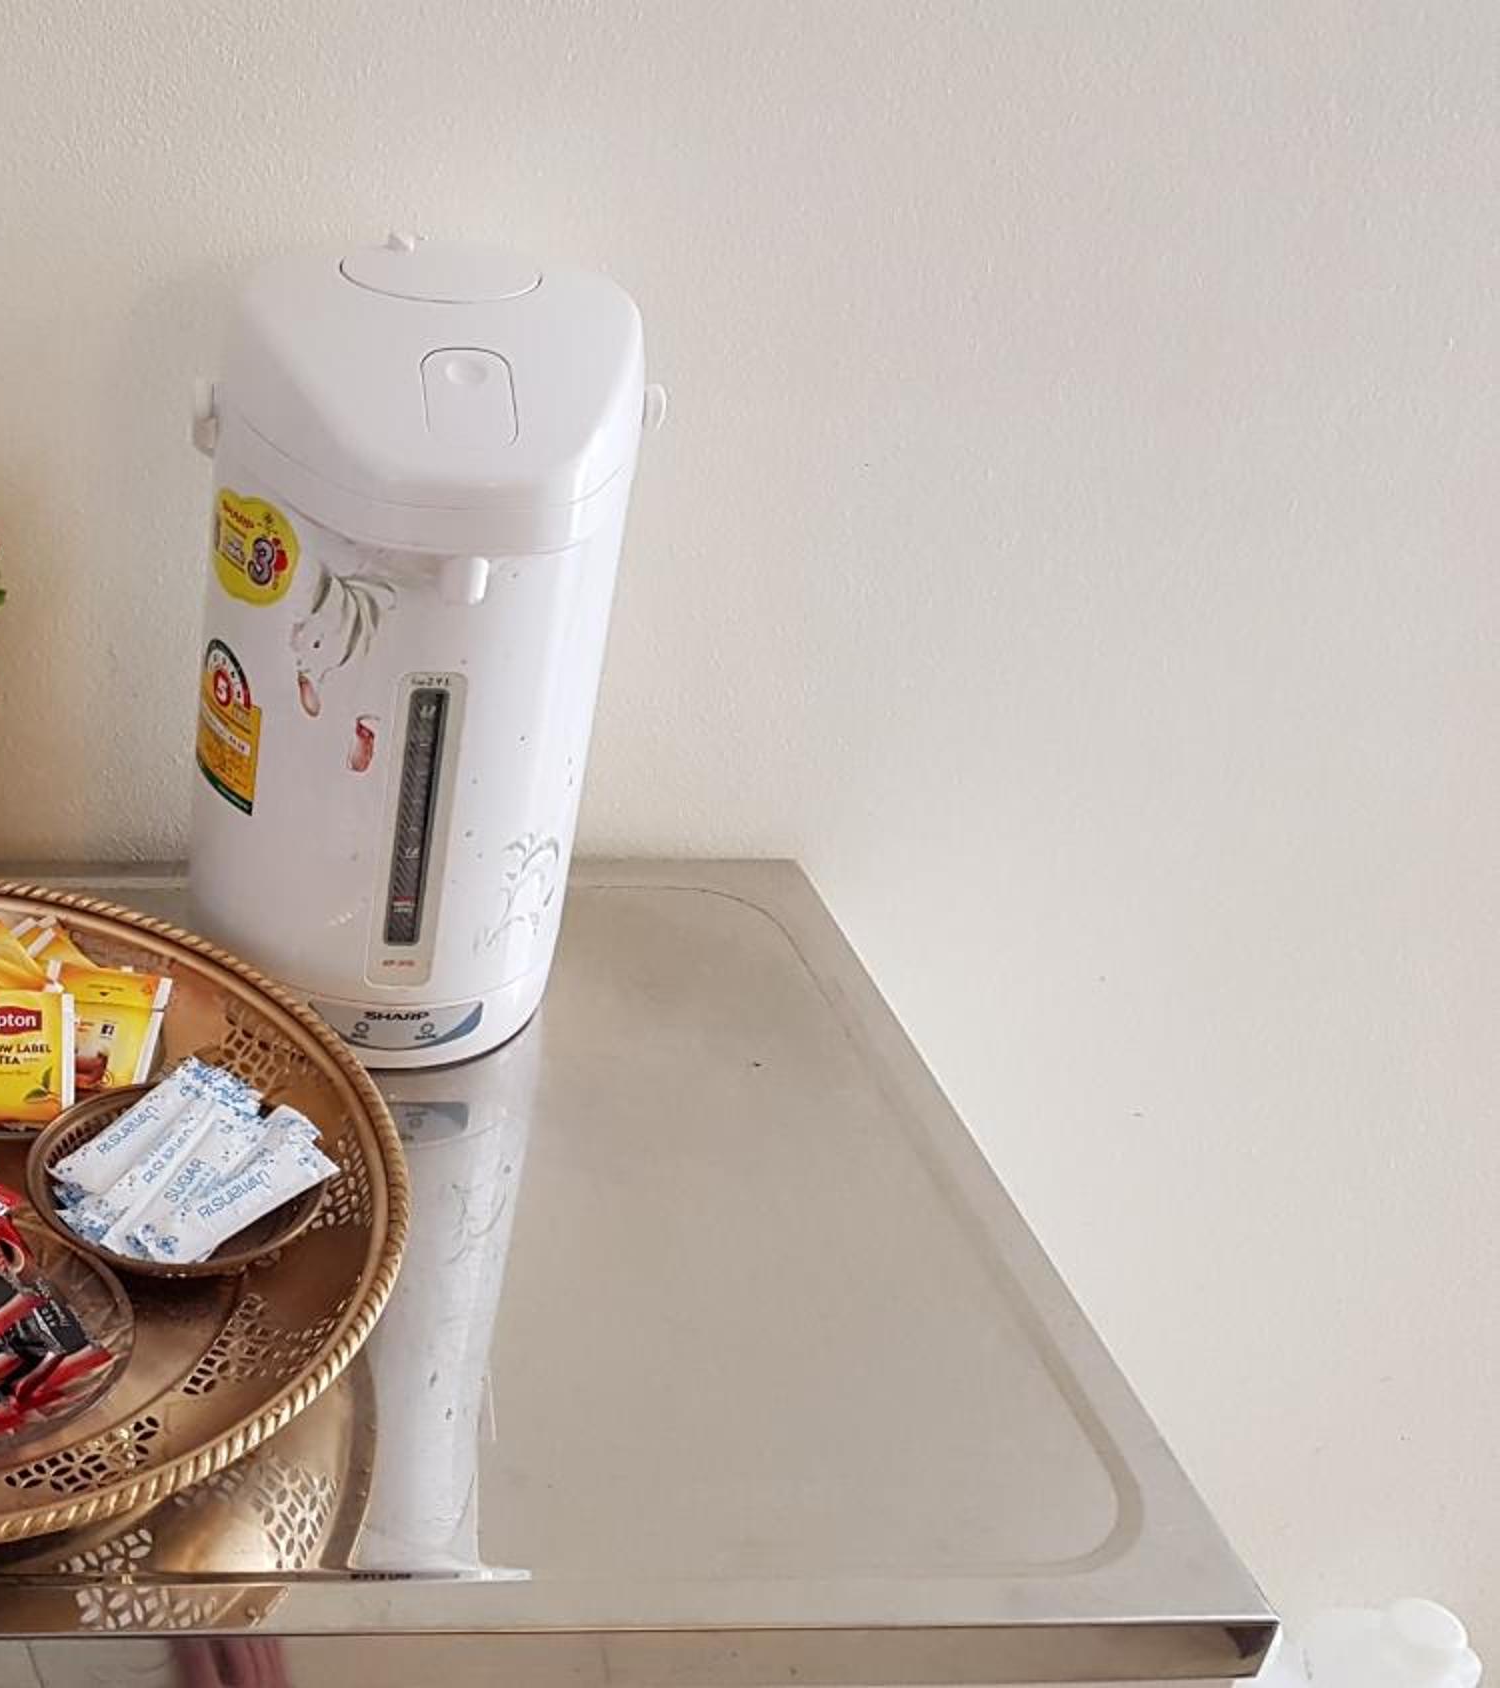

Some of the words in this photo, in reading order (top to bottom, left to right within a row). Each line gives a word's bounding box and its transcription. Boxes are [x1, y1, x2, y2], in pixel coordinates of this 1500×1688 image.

[363, 1011, 430, 1020] SHARP
[17, 1043, 52, 1053] LABEL
[0, 1055, 20, 1065] TEA
[164, 1158, 206, 1203] SUGAR
